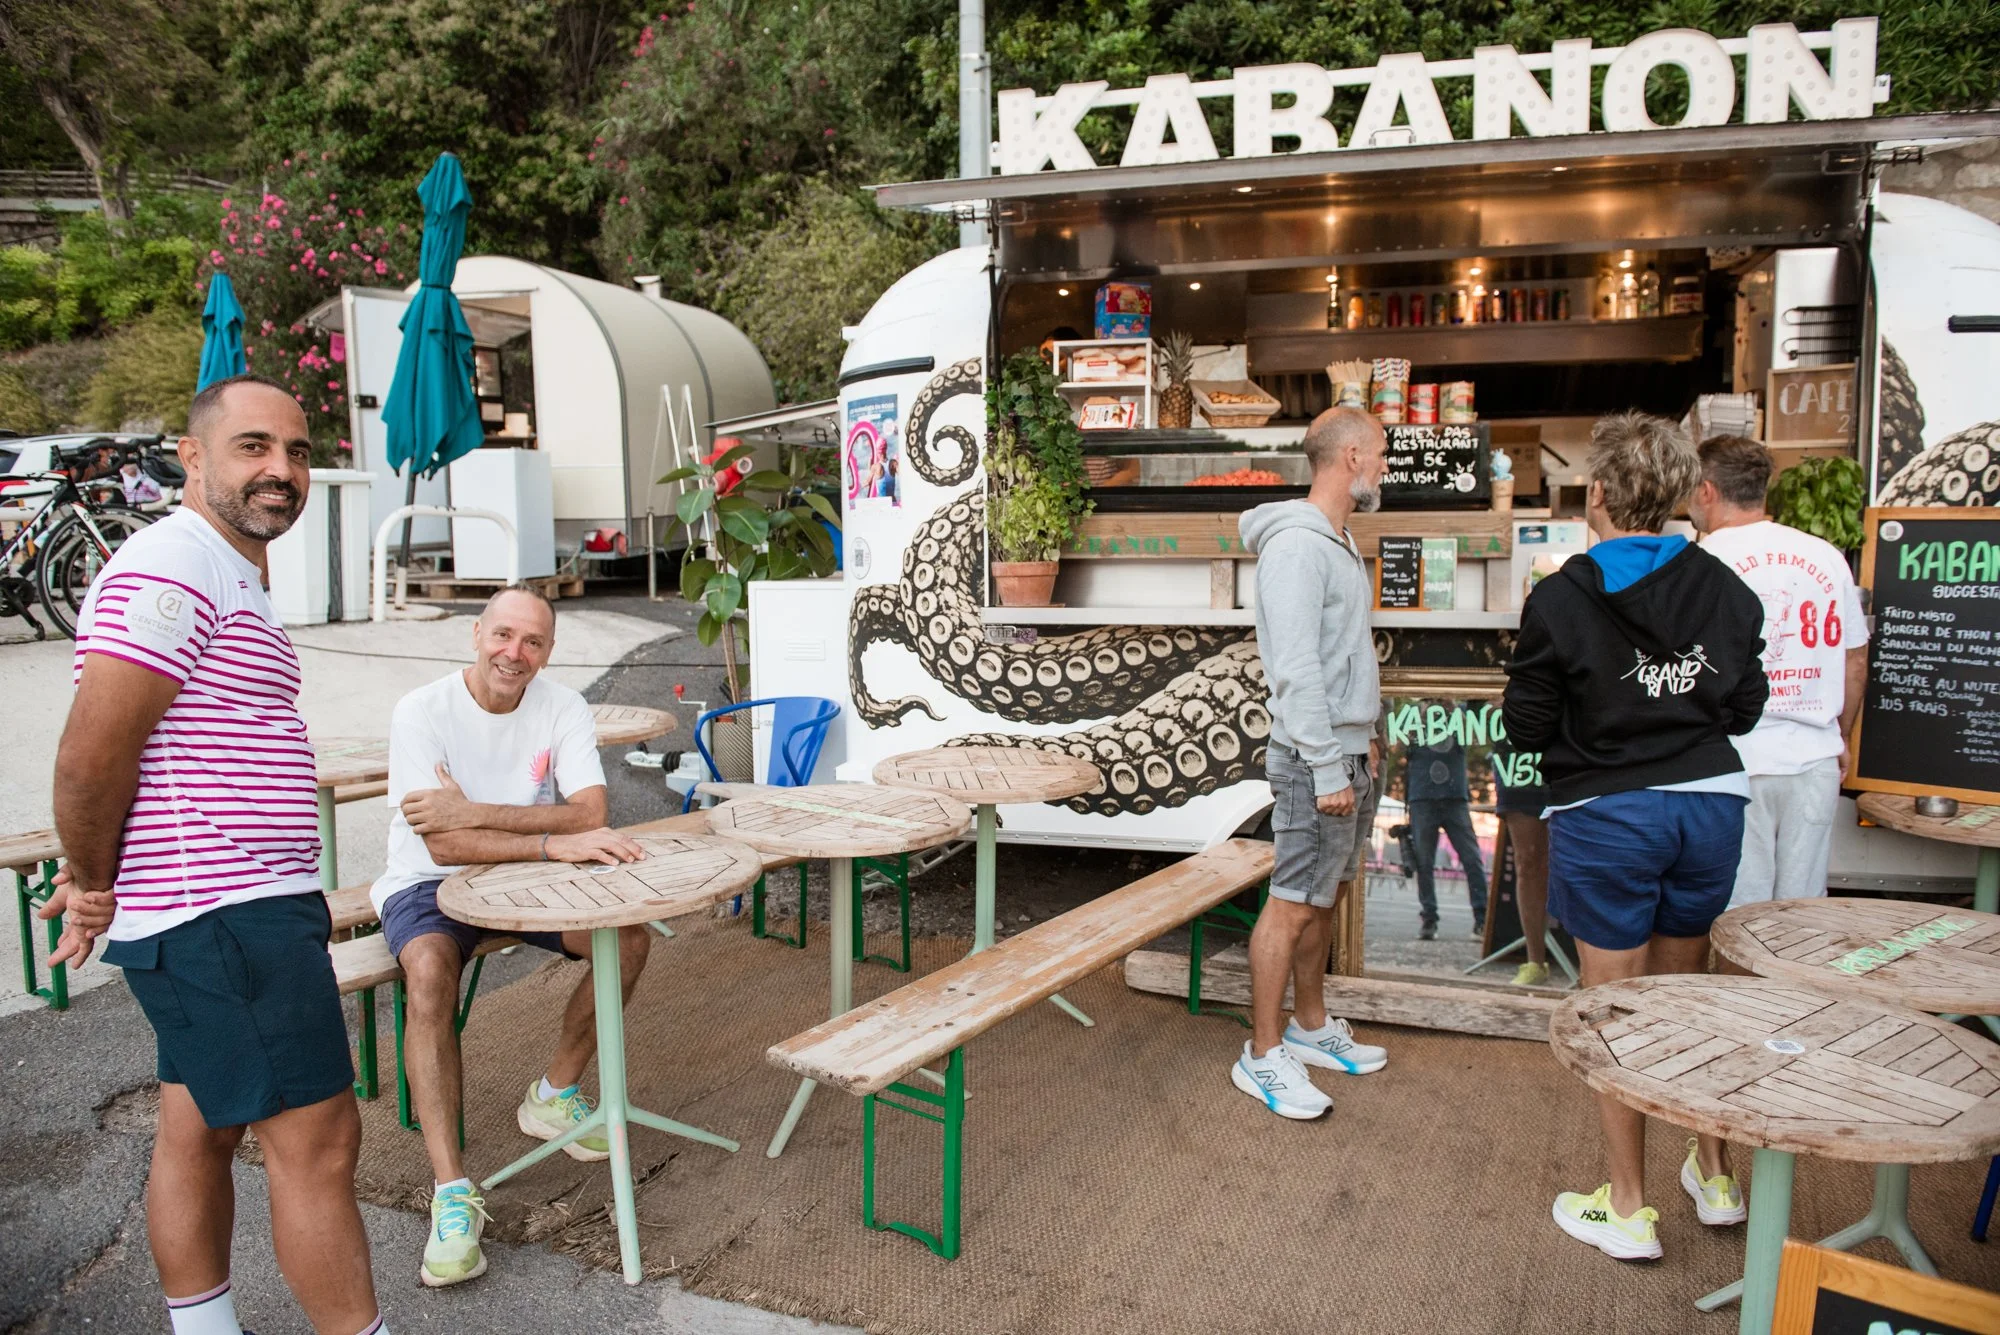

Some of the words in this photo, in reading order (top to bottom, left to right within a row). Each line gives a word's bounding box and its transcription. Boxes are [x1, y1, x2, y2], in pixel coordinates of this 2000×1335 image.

[998, 16, 1879, 176] KABANON
[1393, 437, 1479, 451] RESTAURANT
[1384, 455, 1414, 466] imum
[1423, 451, 1447, 468] 5€
[1380, 471, 1439, 484] NON.VSM
[1765, 552, 1835, 595] FAMOUS
[1799, 600, 1842, 648] 86
[1883, 621, 1929, 636] BURGER
[1934, 626, 1952, 638] DE
[1956, 629, 1991, 641] THON
[1946, 642, 1964, 653] DU
[1637, 659, 1701, 684] GRAND
[1766, 667, 1822, 681] MPION
[1770, 684, 1802, 697] ANUTS
[1879, 671, 1931, 688] GAUFRE
[1935, 677, 1958, 691] AU
[1963, 681, 2000, 694] NUTE
[1387, 704, 1512, 747] KABANO
[1580, 1209, 1608, 1223] HOKA
